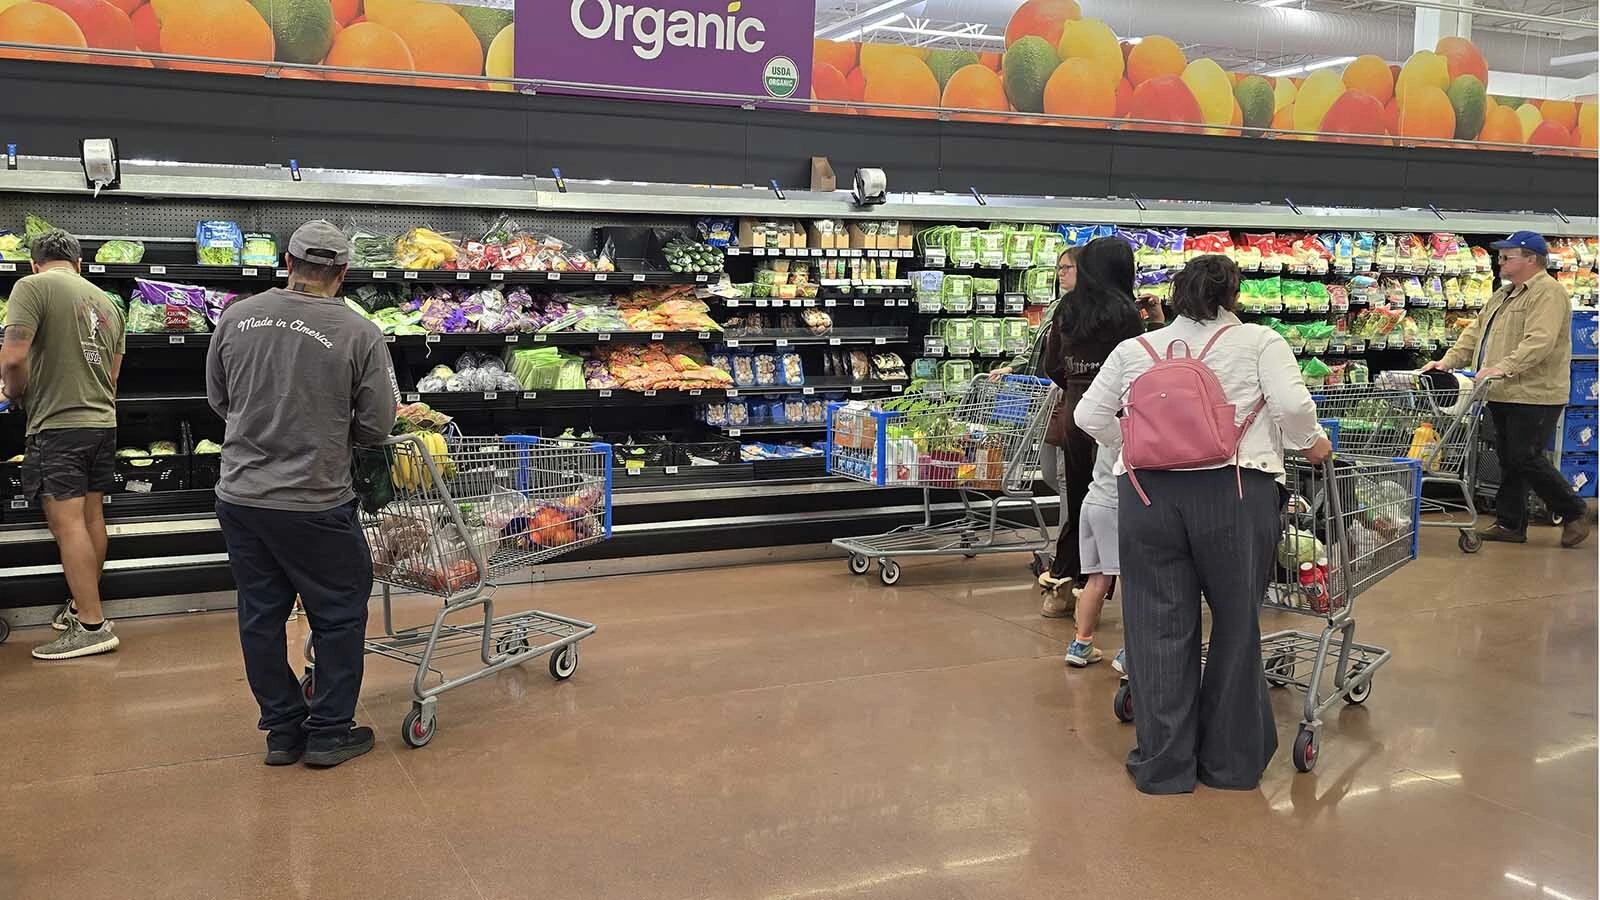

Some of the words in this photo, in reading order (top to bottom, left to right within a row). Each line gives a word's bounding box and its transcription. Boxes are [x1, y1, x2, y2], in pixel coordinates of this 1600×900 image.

[571, 0, 765, 60] Organic
[768, 78, 794, 87] ORGANIC
[772, 66, 791, 77] USDA
[237, 316, 273, 332] Made
[275, 318, 287, 328] in
[290, 319, 334, 349] America
